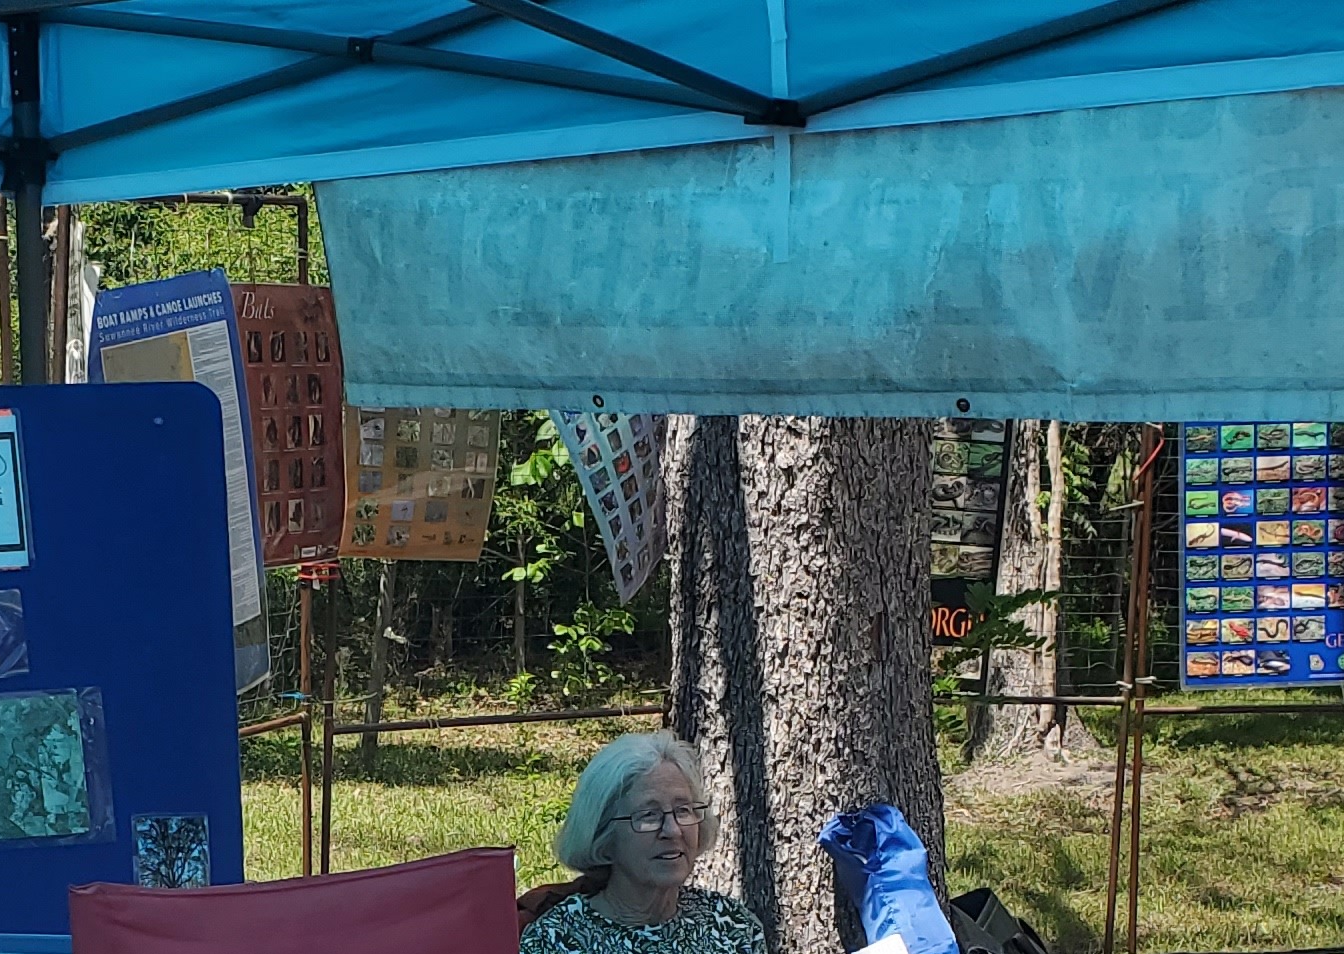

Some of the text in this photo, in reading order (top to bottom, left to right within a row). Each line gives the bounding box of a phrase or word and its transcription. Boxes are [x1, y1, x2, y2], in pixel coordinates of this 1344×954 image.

[97, 315, 119, 330] BOAT
[119, 308, 149, 325] RAMPS
[156, 299, 182, 318] CANOE
[183, 291, 223, 311] LAUNCHES
[241, 290, 275, 319] Bats
[143, 320, 164, 335] River
[167, 312, 207, 330] Wilderness
